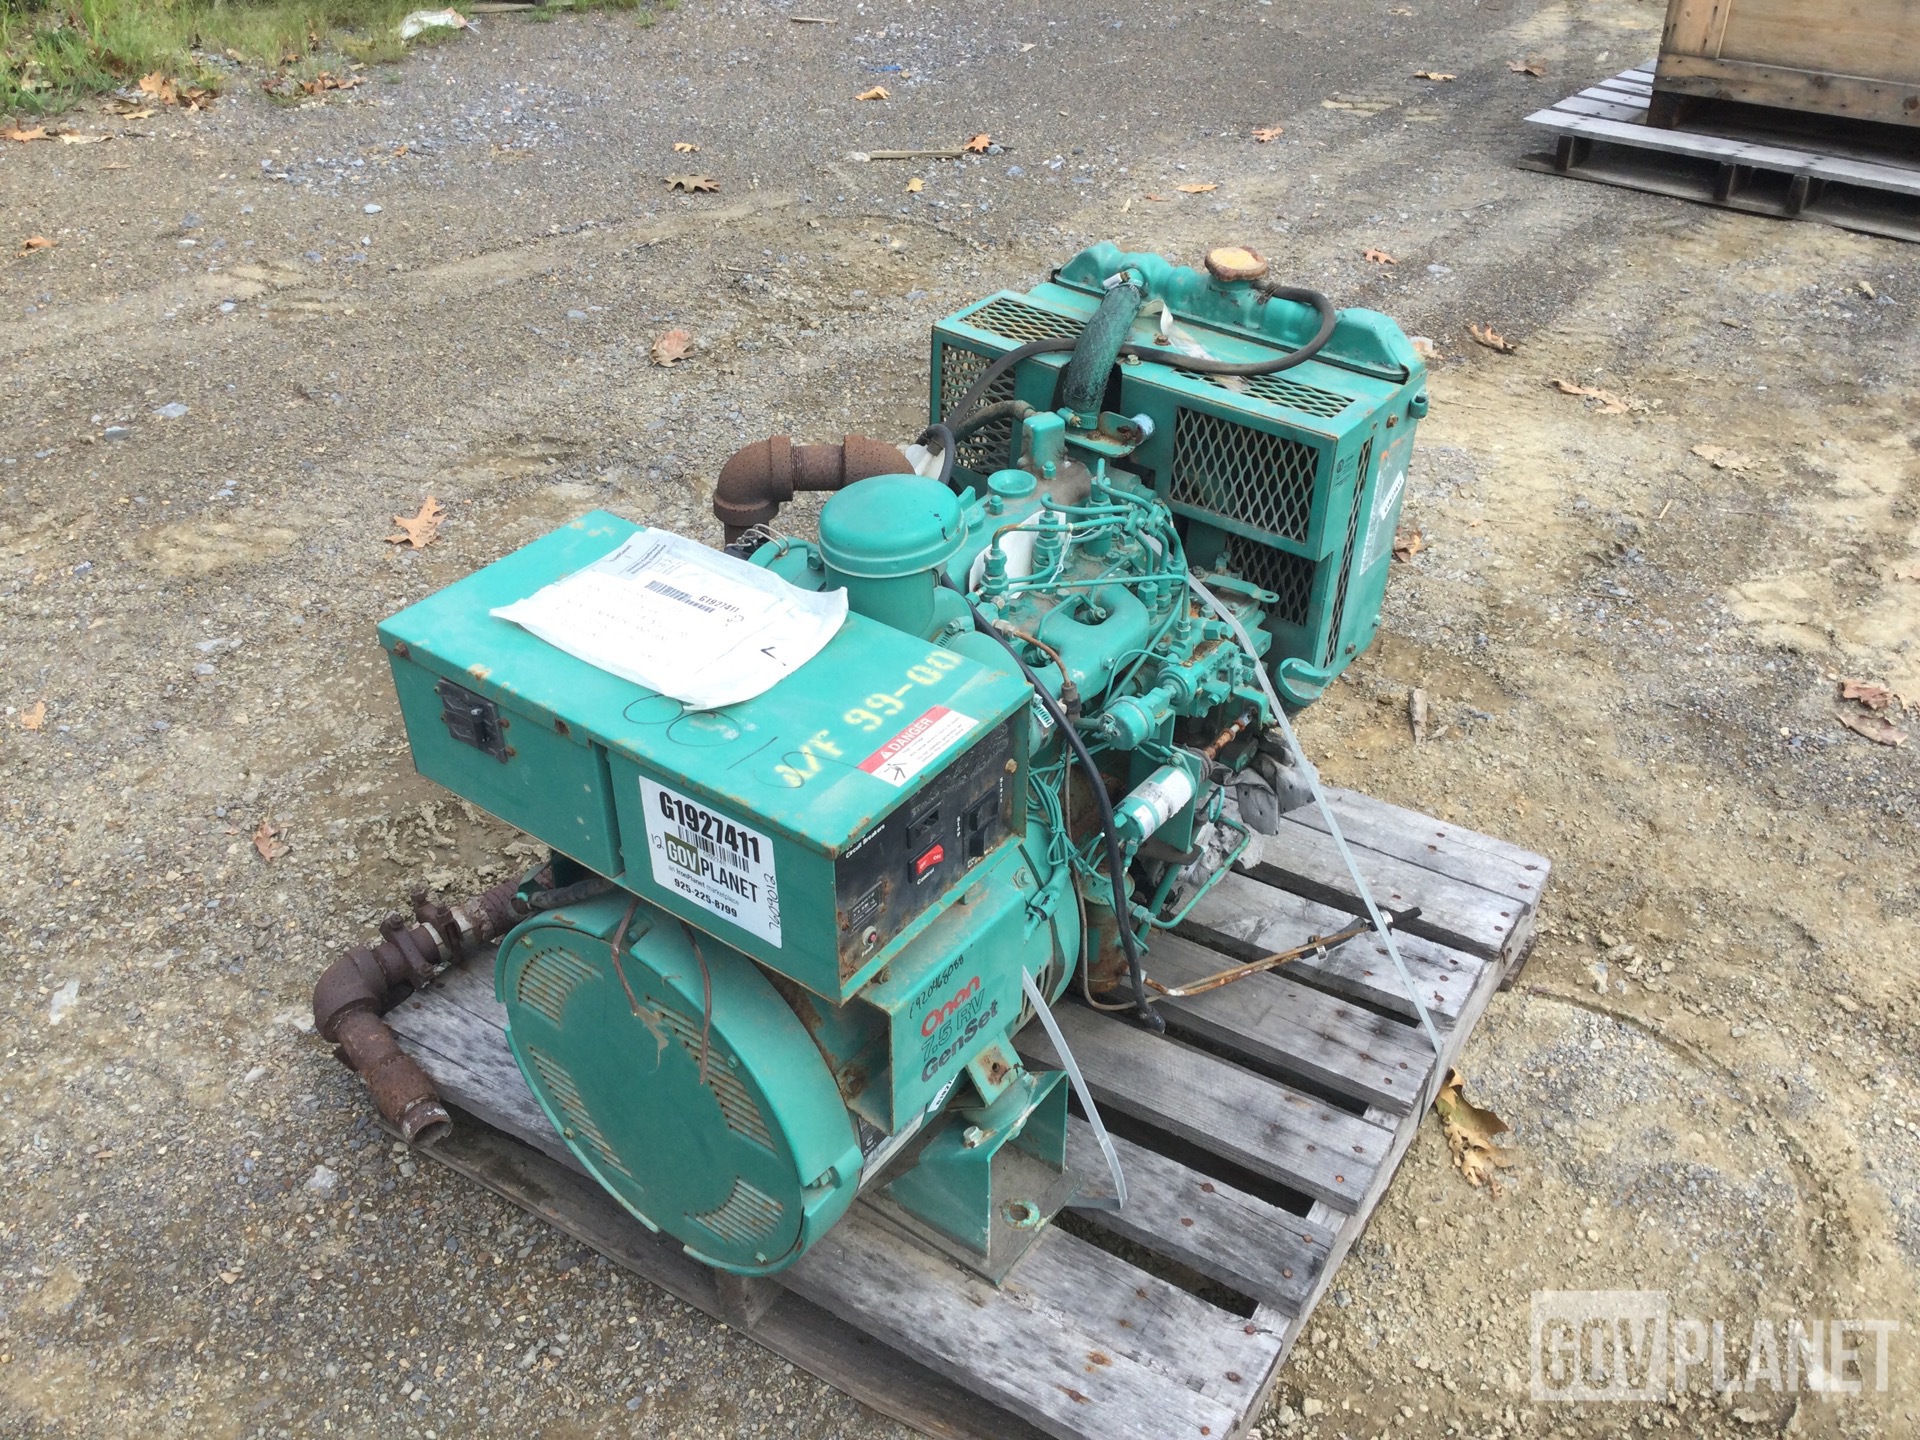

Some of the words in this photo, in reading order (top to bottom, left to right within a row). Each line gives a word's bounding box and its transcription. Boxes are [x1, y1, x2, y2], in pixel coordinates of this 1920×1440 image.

[699, 595, 740, 613] G1927411
[843, 650, 963, 732] 99-00
[889, 717, 933, 752] DANGER
[659, 791, 761, 864] G1927411
[845, 841, 862, 859] Circuit
[862, 823, 886, 845] Breakers
[674, 878, 738, 918] 925-225-8799
[916, 867, 935, 885] Control
[921, 975, 980, 1037] Onan
[921, 1019, 953, 1062] 7.5
[956, 988, 986, 1031] RV
[921, 999, 998, 1083] GenSet
